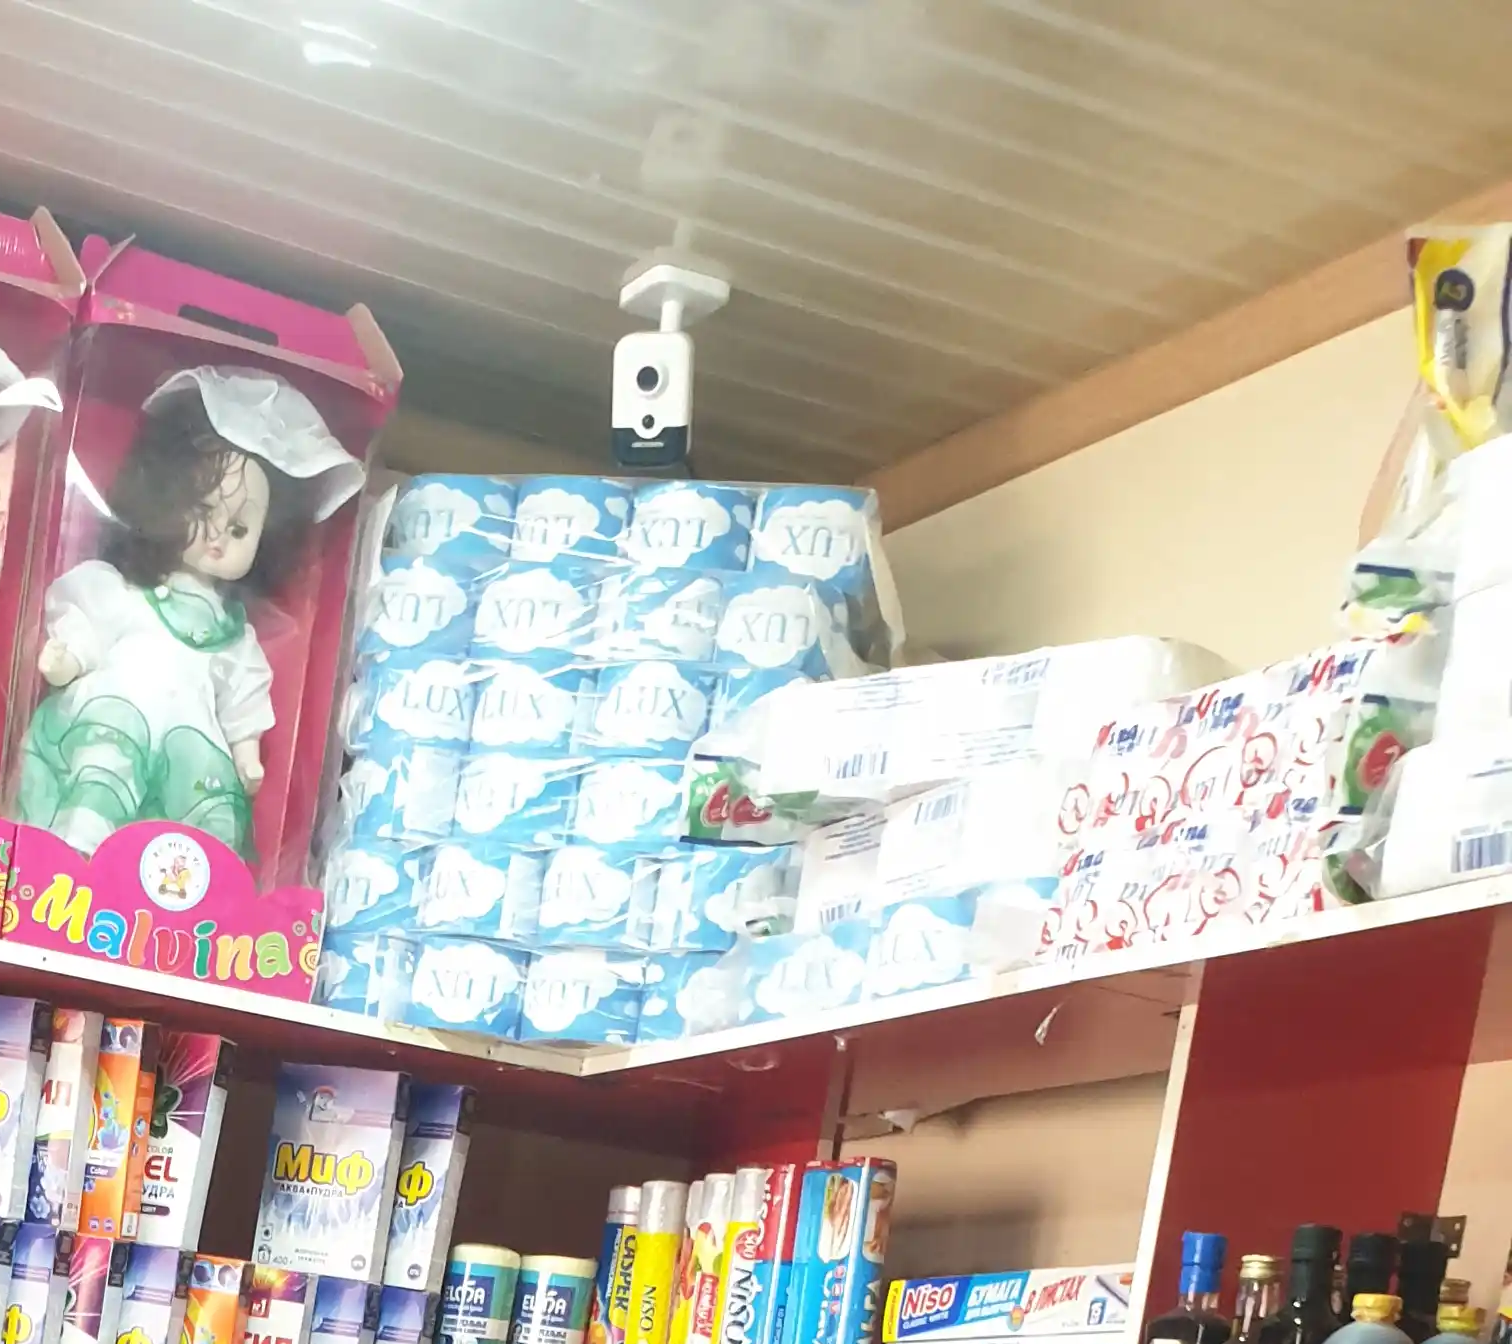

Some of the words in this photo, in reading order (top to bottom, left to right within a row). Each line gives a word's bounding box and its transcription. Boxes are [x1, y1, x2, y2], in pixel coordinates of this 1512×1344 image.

[401, 681, 467, 716] LUX
[32, 873, 293, 981] Malvina
[89, 1166, 110, 1177] Color
[143, 1155, 178, 1184] EL
[275, 1141, 374, 1195] Миф
[142, 1185, 176, 1199] УДРА
[639, 1285, 657, 1332] NISO
[901, 1281, 957, 1321] Niso
